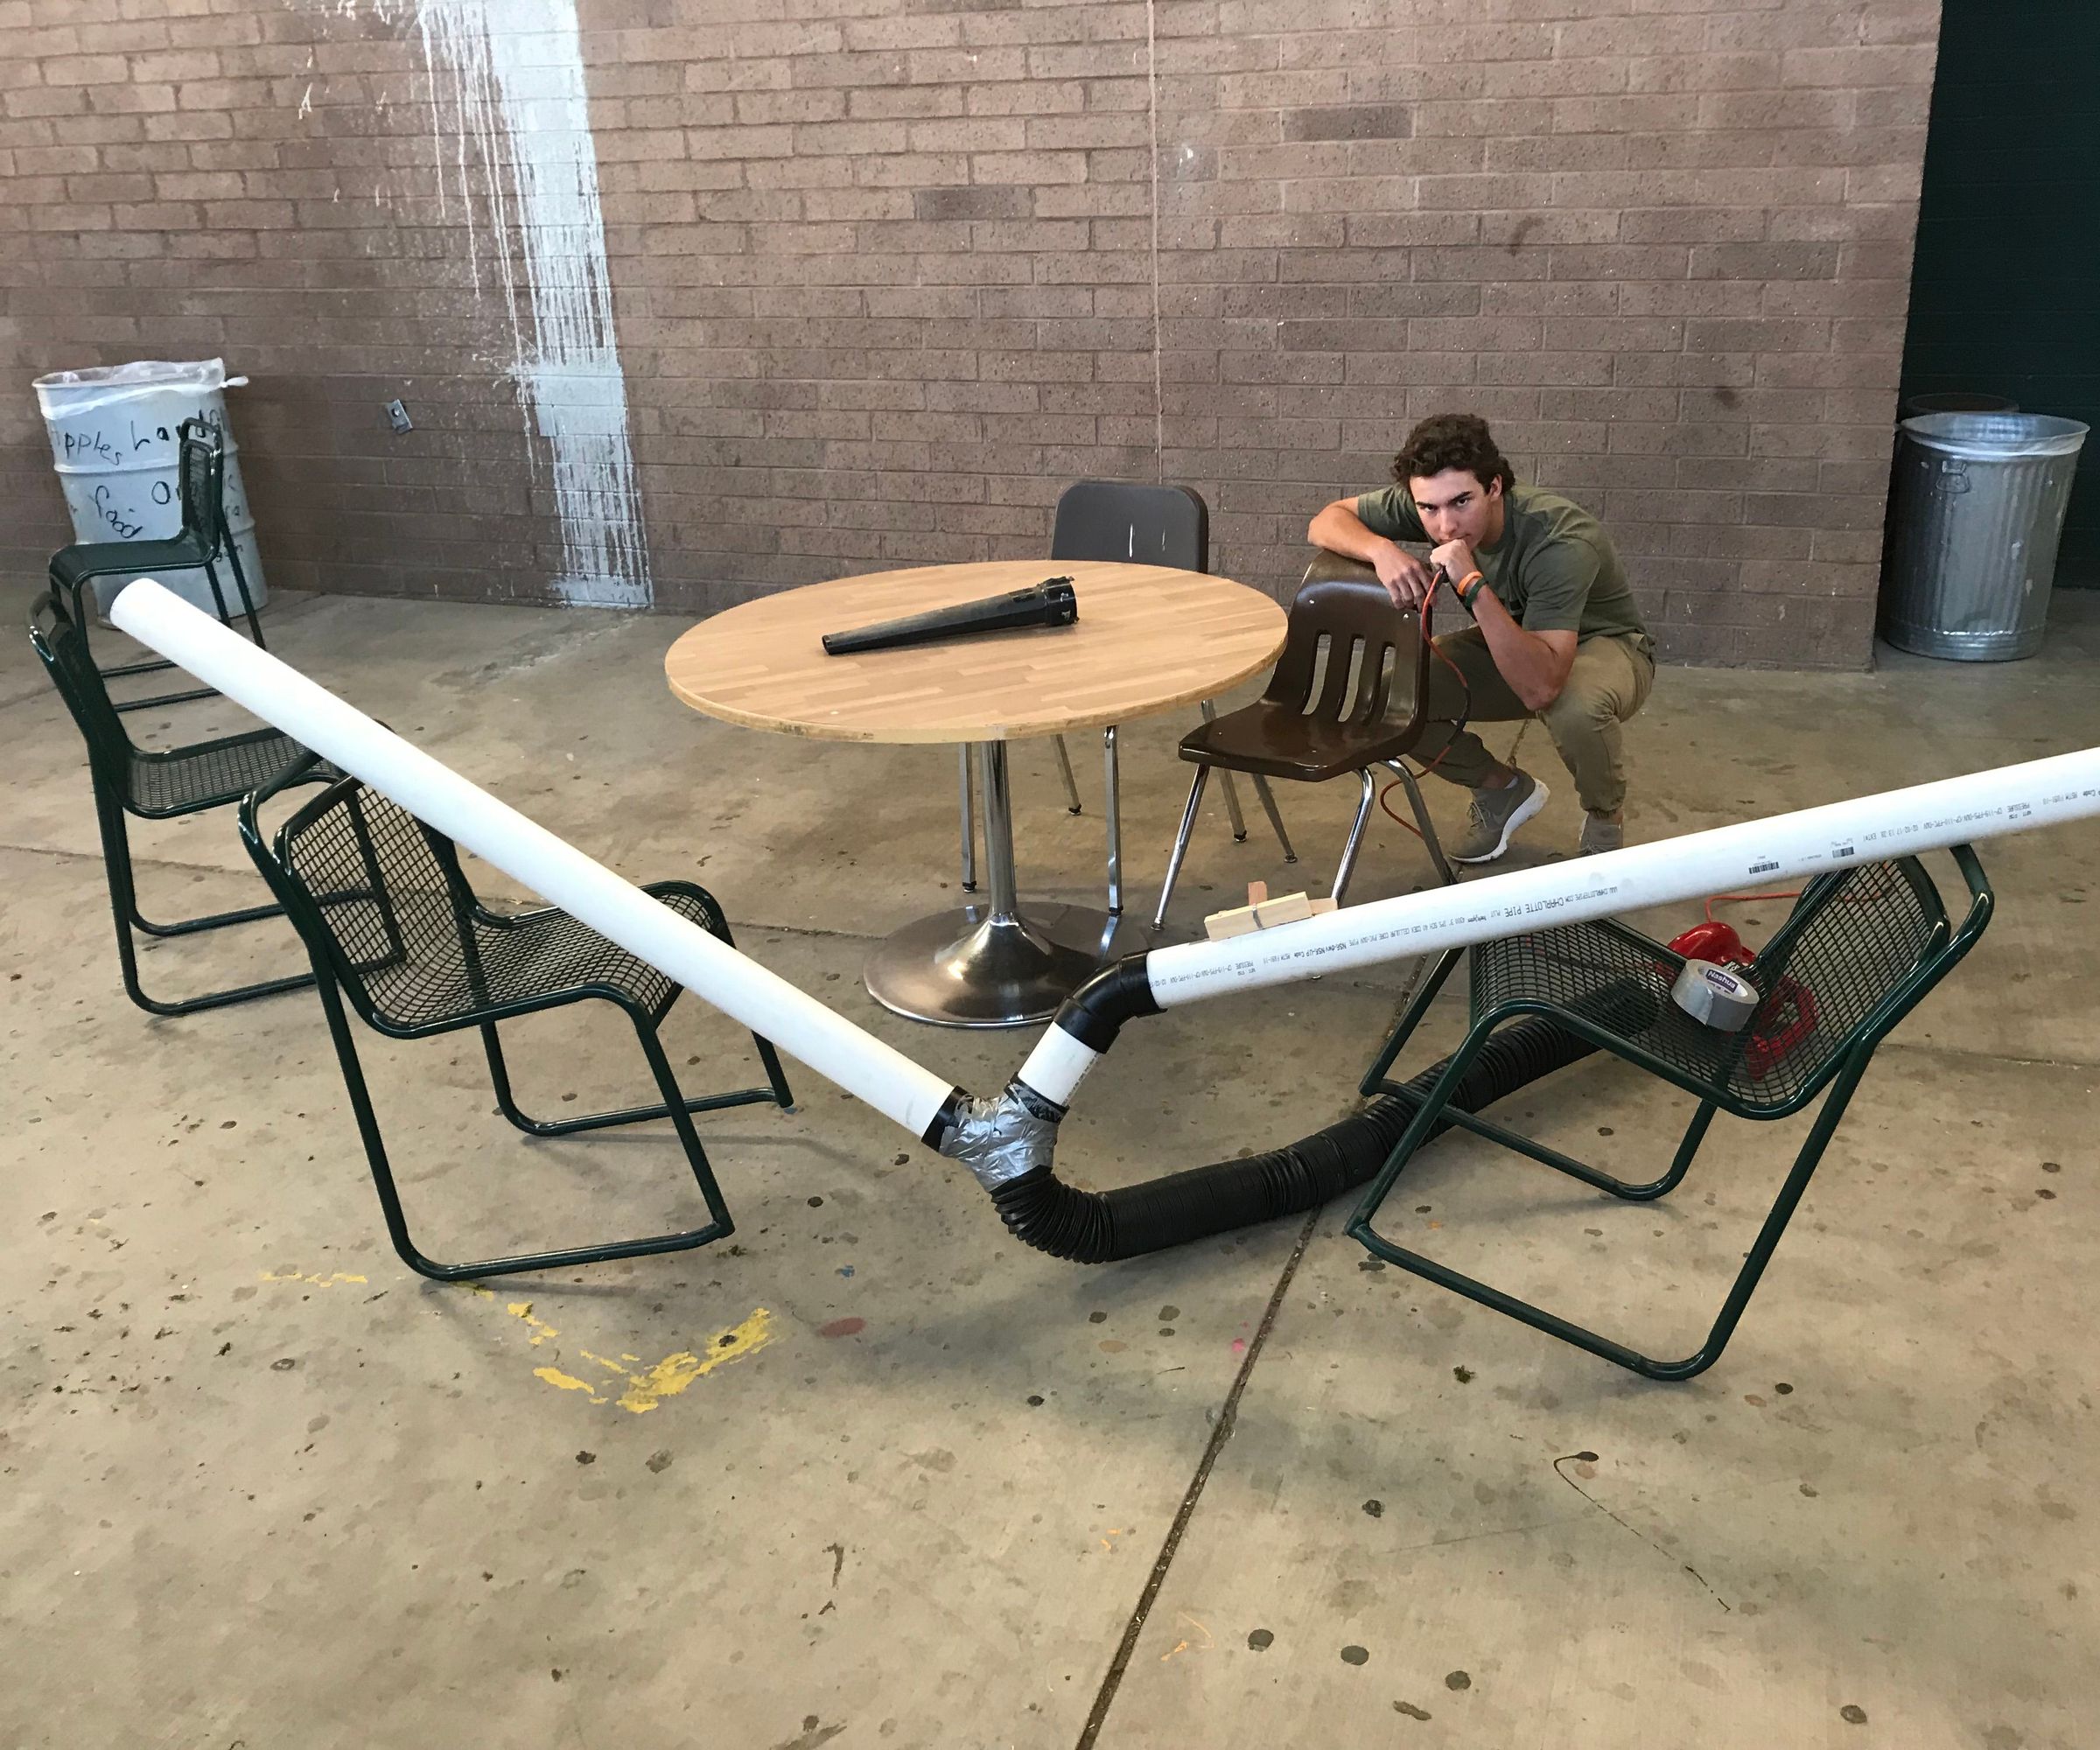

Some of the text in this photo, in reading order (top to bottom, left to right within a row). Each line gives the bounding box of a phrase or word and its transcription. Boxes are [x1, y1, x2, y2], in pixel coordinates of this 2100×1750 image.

[1503, 905, 1522, 917] PIPE
[1524, 897, 1564, 913] CHARLOTTE
[1707, 970, 1736, 989] Nashua
